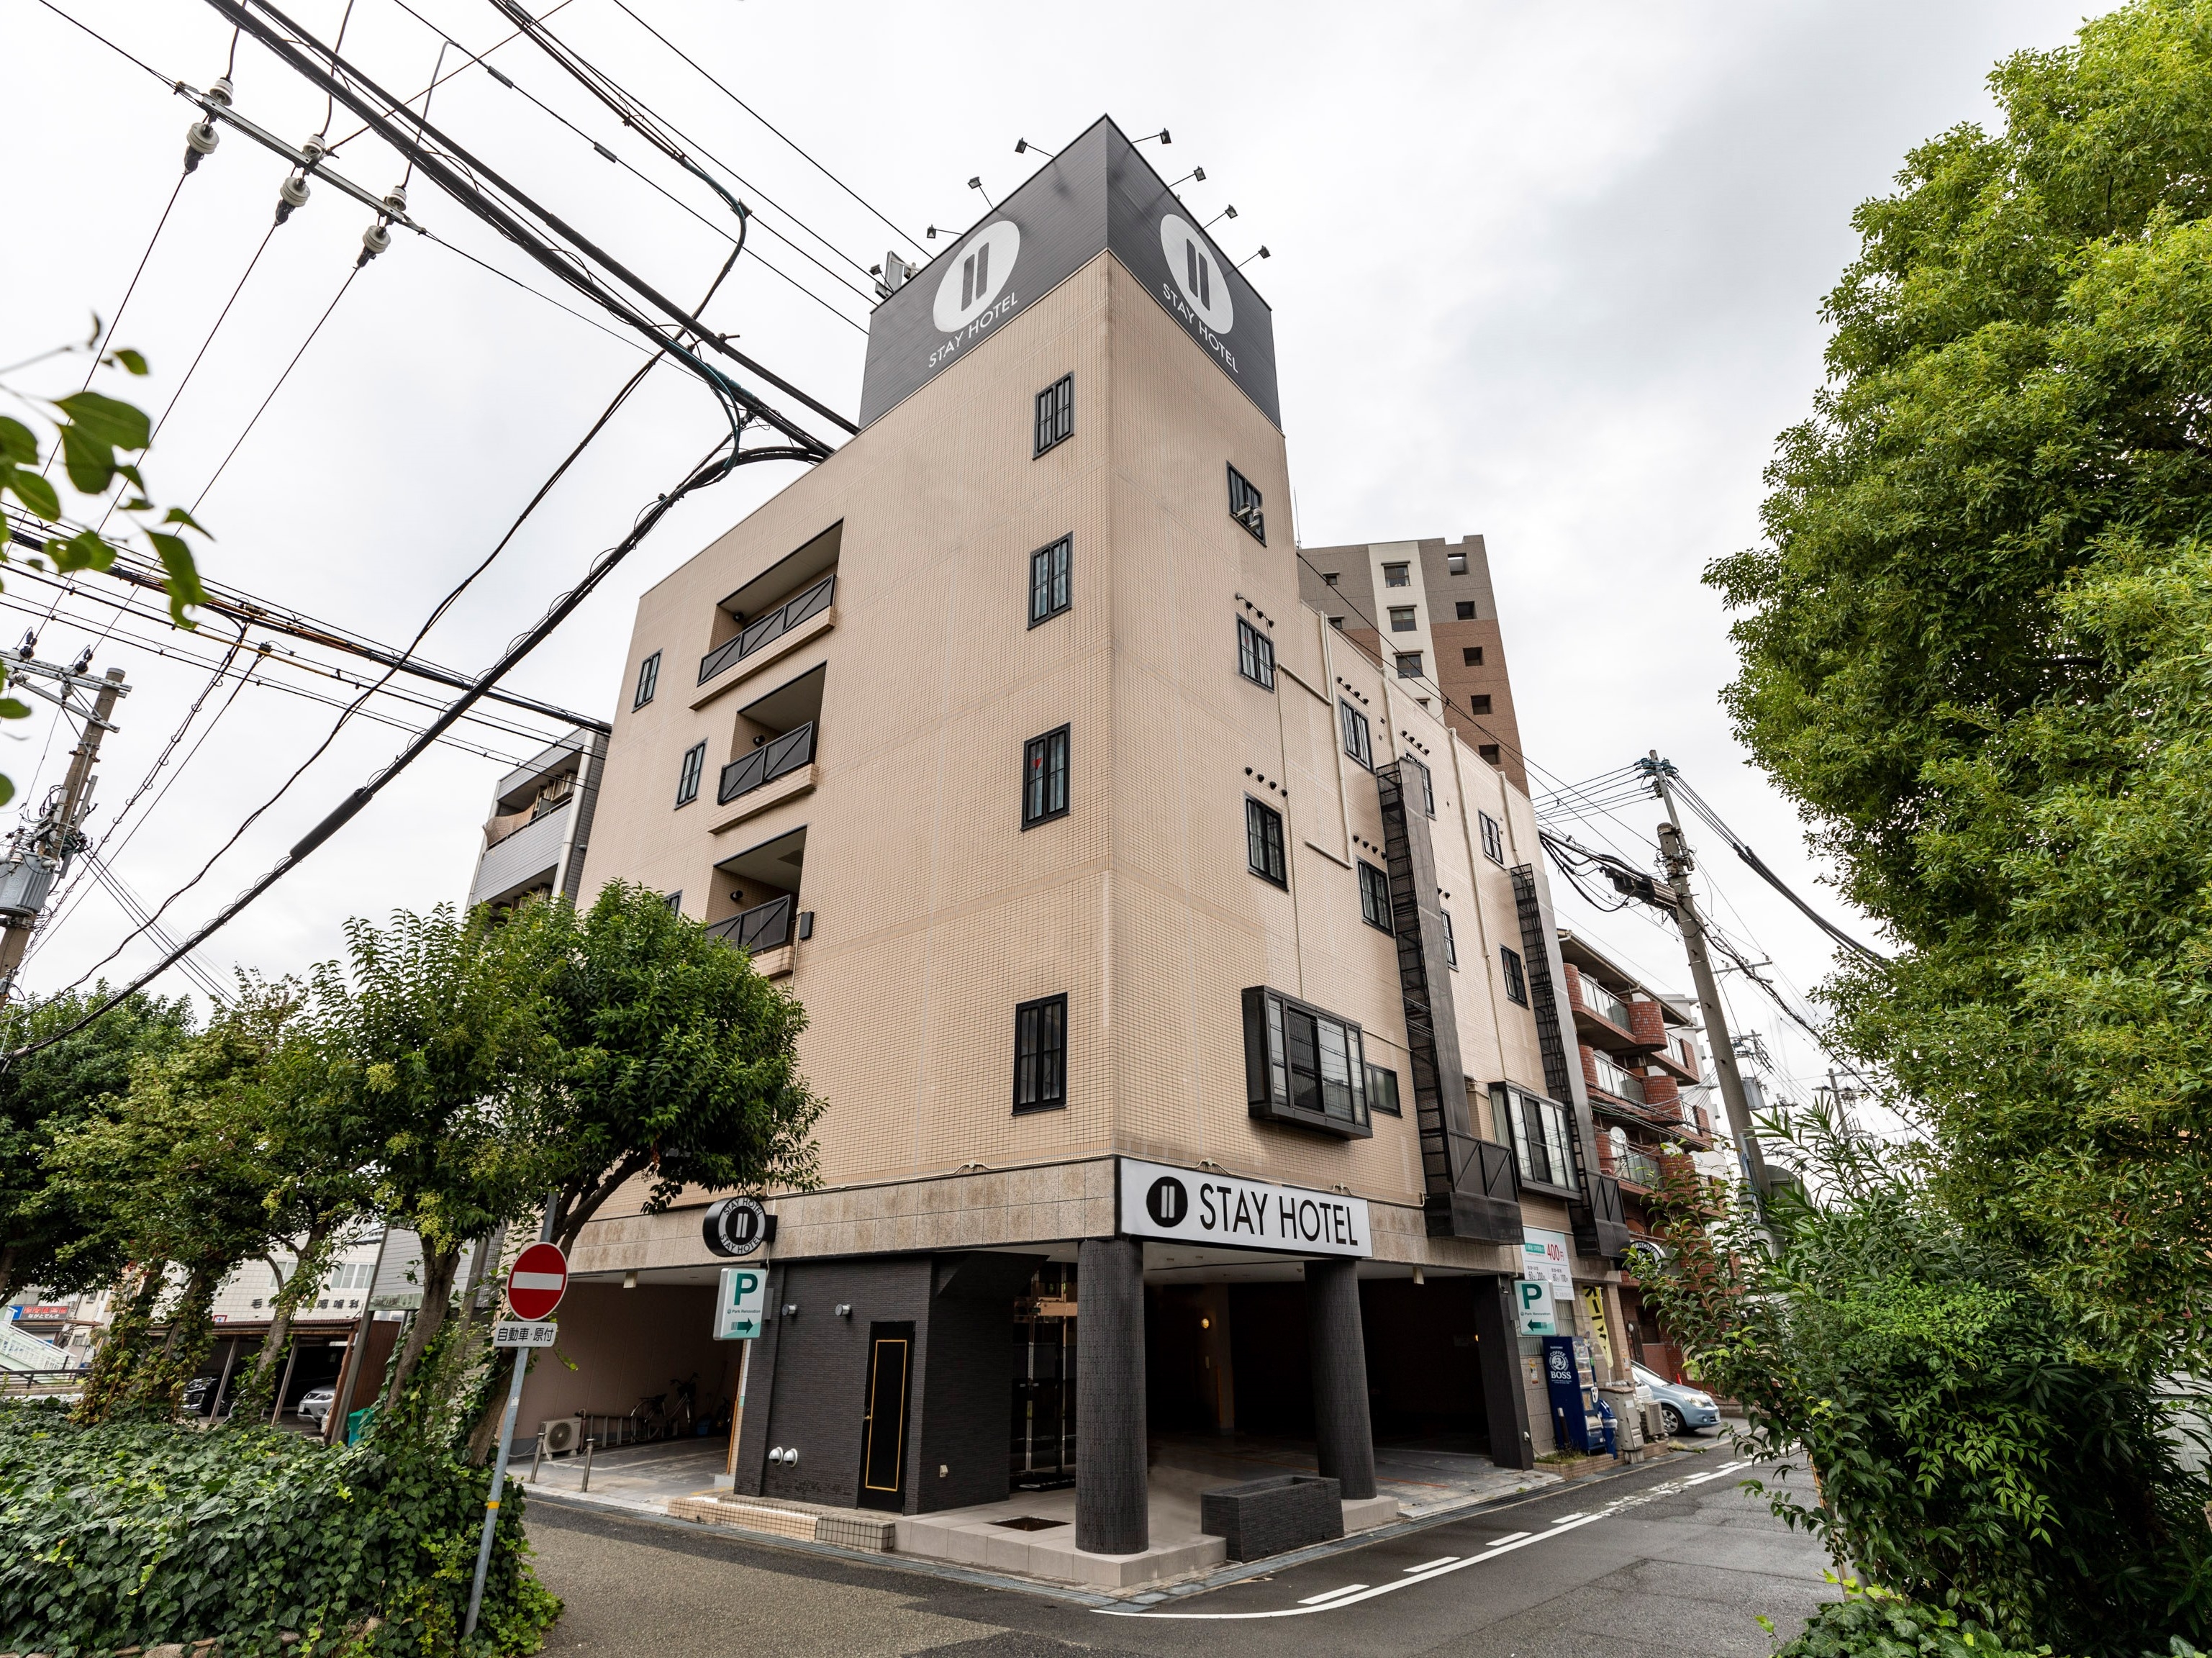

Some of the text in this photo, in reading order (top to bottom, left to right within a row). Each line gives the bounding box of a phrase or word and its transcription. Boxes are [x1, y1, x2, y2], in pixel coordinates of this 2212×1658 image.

[928, 291, 1018, 368] STAY HOTEL
[1163, 283, 1238, 373] STAY HOTEL
[723, 1197, 763, 1218] STAY HOTEL
[1200, 1182, 1359, 1246] STAY HOTEL
[720, 1233, 761, 1254] STAY HOTEL
[734, 1273, 758, 1306] P
[1521, 1283, 1543, 1310] P
[497, 1327, 554, 1342] 自動車・原付
[1550, 1370, 1572, 1380] BOSS
